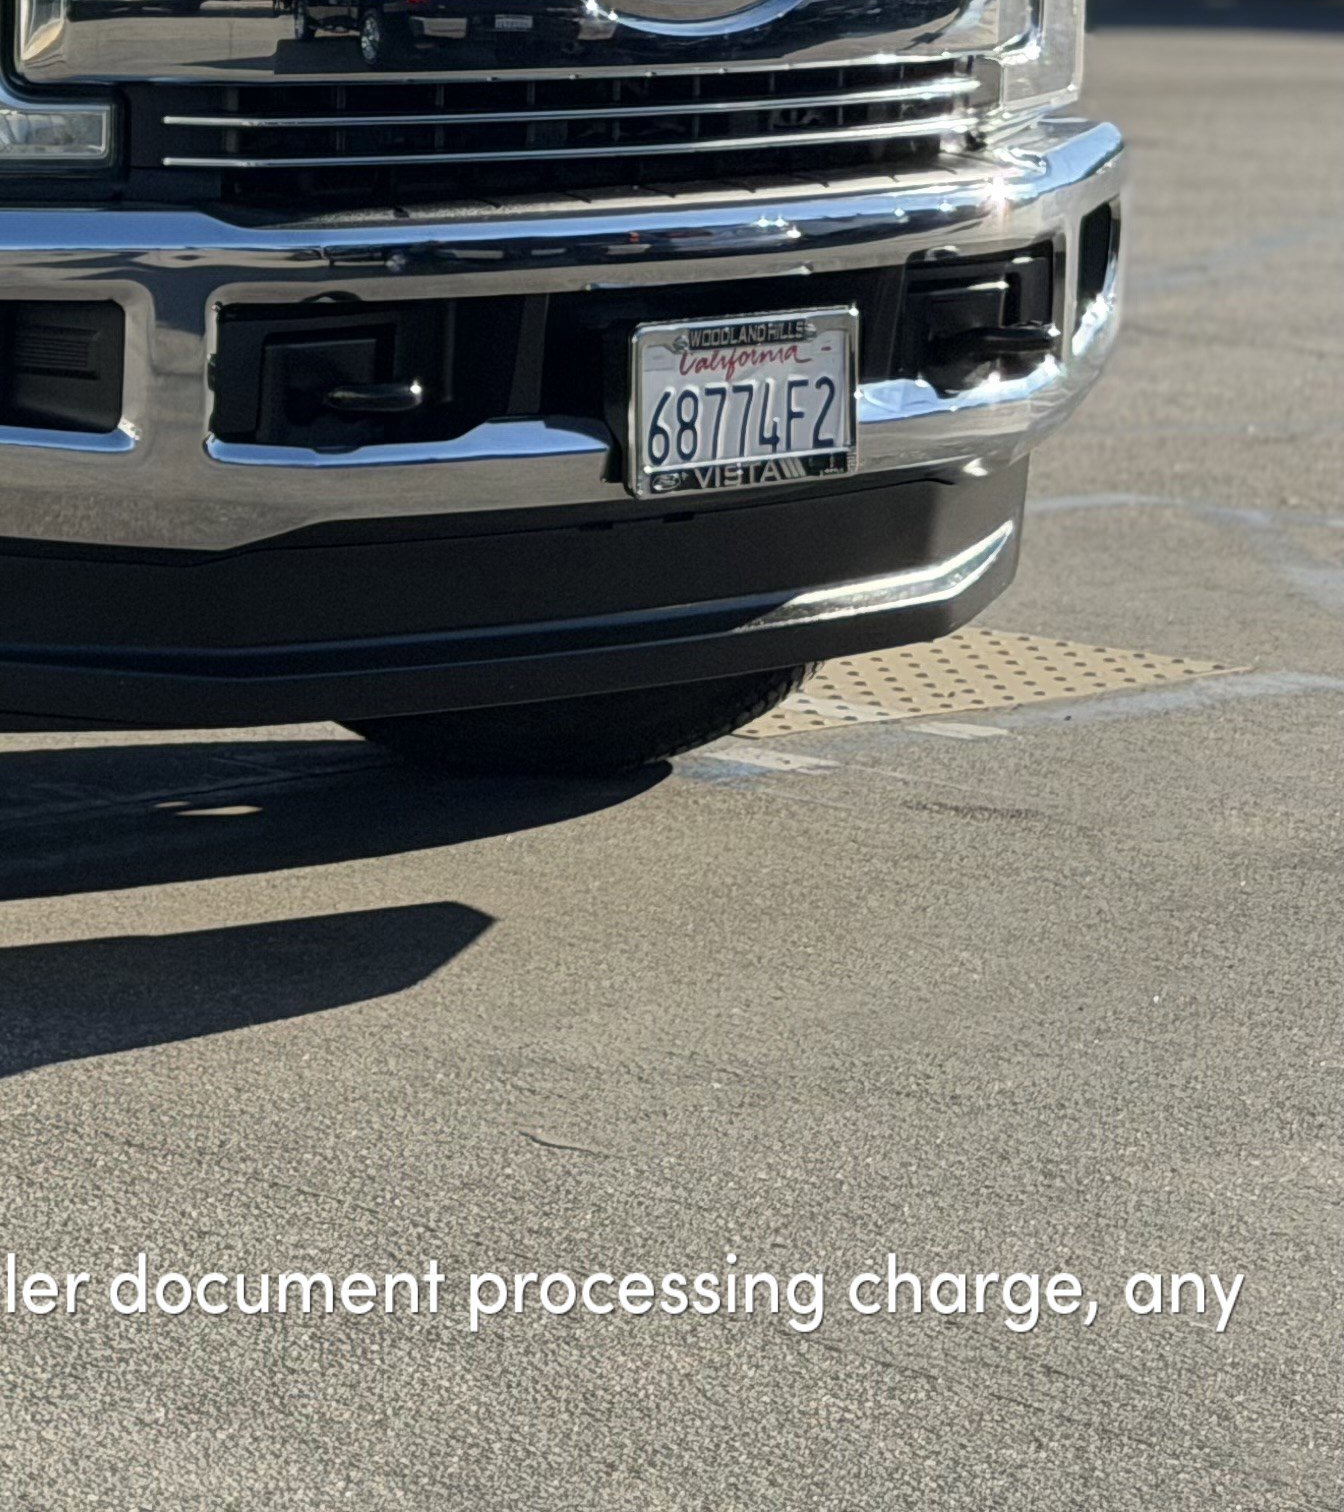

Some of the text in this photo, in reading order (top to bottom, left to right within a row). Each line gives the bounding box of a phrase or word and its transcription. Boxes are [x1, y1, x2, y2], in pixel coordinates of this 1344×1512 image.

[688, 320, 805, 351] WOODLAND HILLS
[678, 345, 813, 379] California
[646, 374, 837, 467] 68774F2
[694, 457, 783, 490] VISTA
